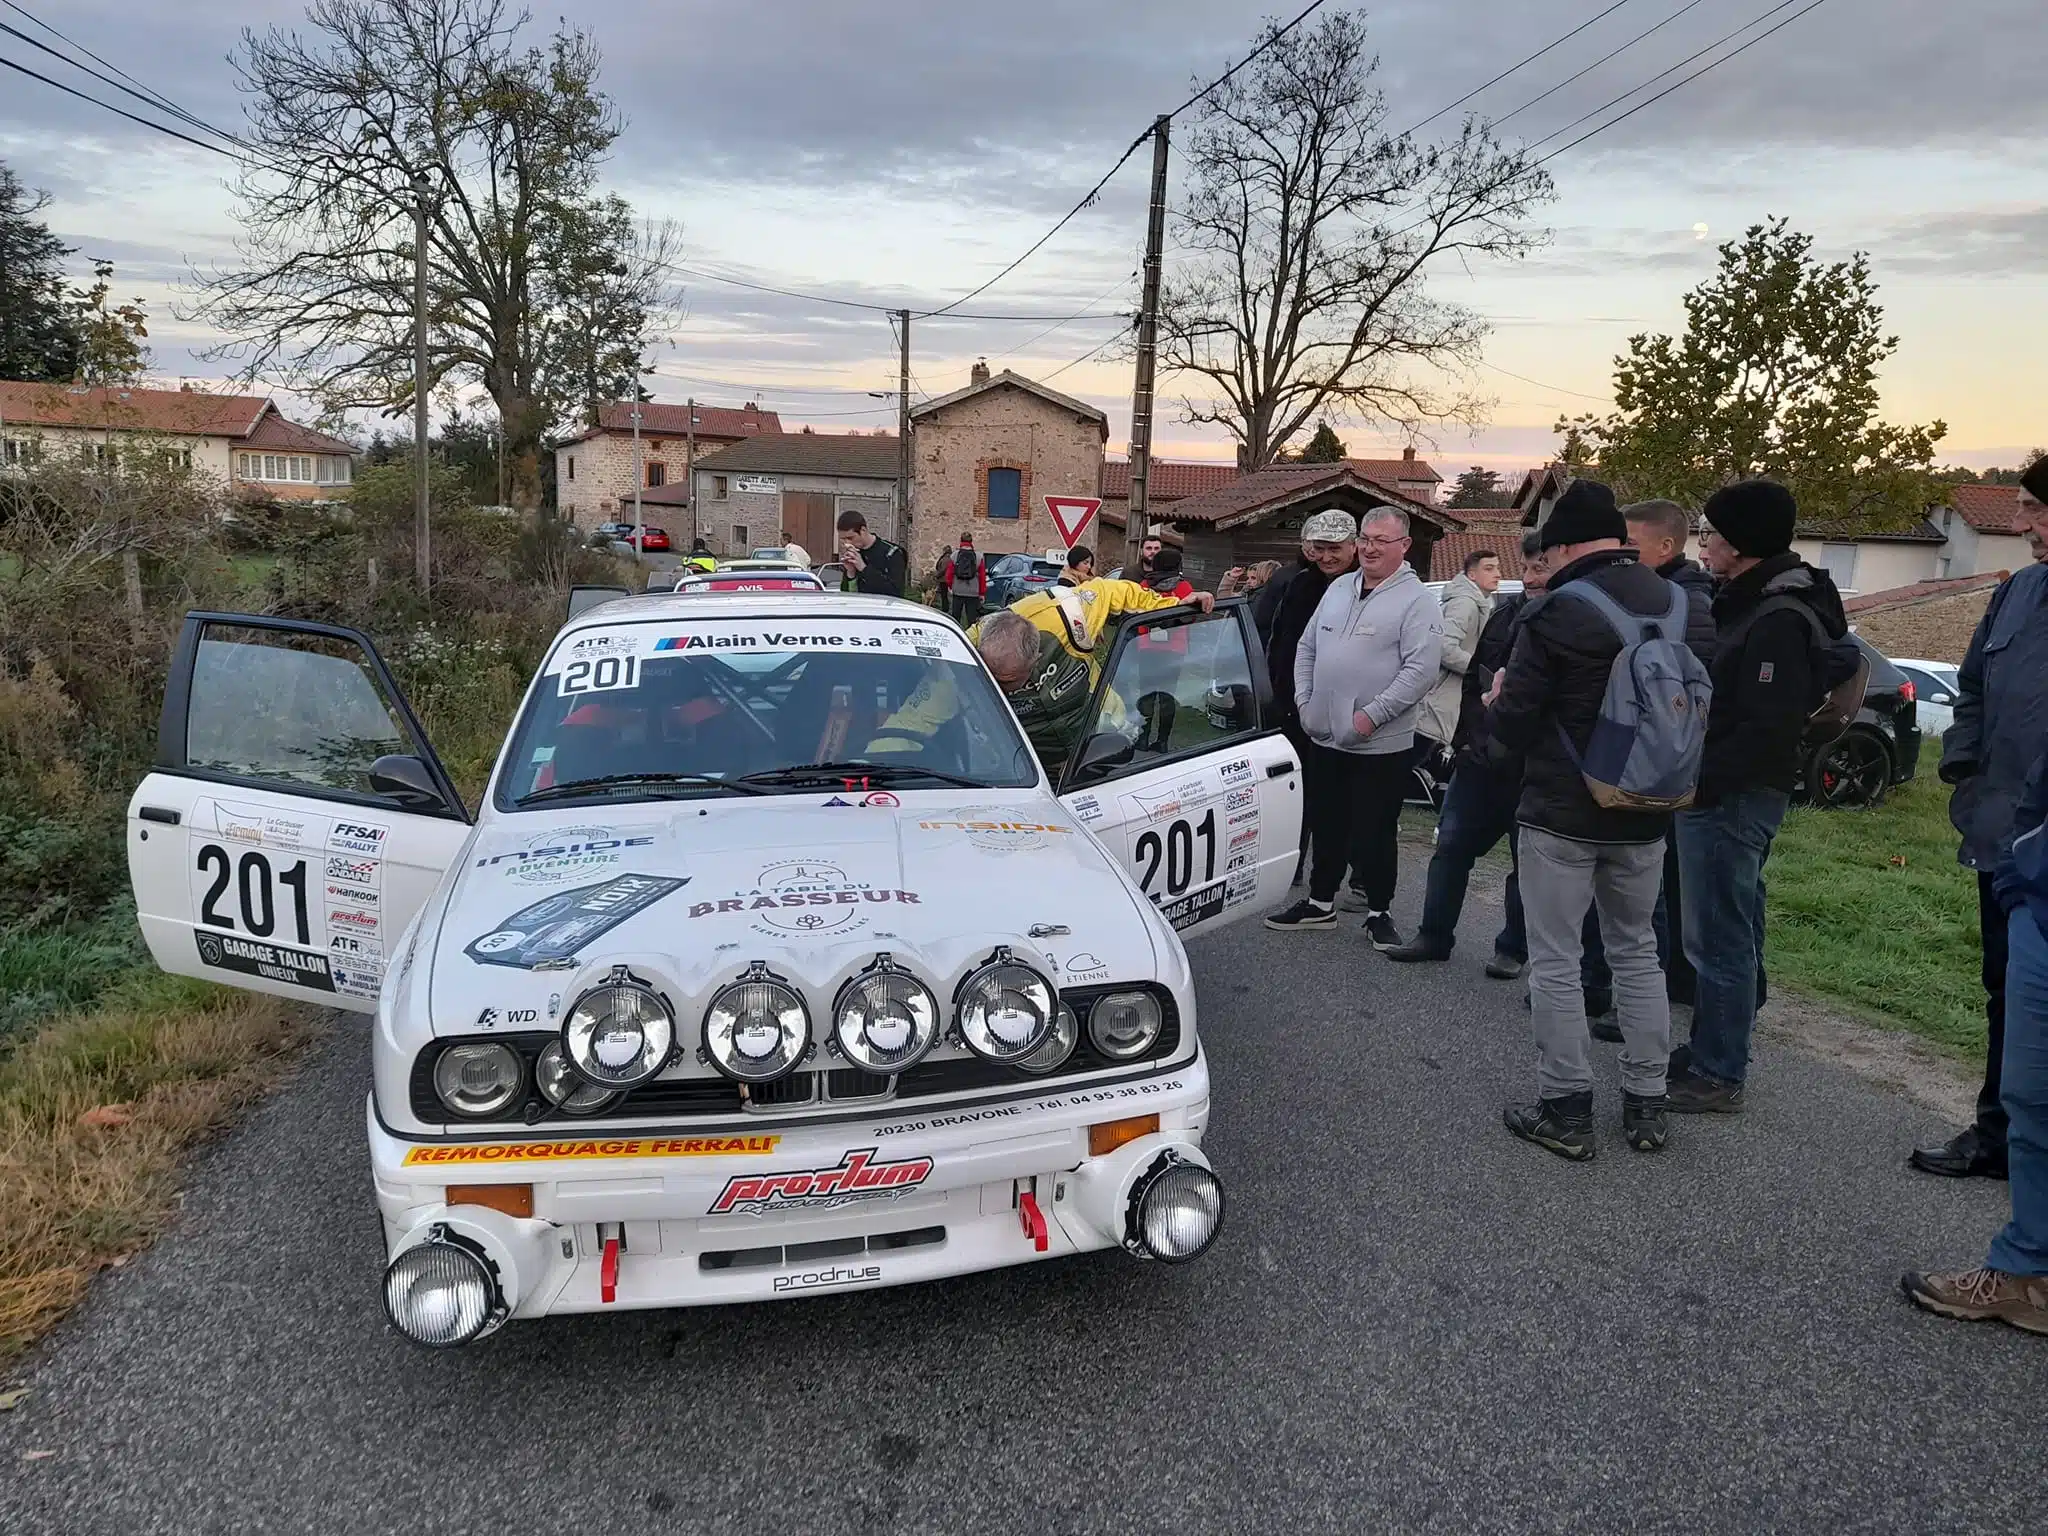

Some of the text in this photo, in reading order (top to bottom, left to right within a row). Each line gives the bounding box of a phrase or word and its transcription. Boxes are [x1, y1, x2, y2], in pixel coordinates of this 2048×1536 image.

[736, 584, 763, 592] AVIS
[686, 634, 756, 648] Alain
[762, 633, 845, 647] Verne
[850, 636, 882, 648] s.a
[891, 627, 923, 636] ATR
[573, 637, 609, 648] ATR
[563, 655, 635, 693] 201
[345, 839, 378, 853] RALLYE
[476, 836, 655, 868] INSIDE
[1135, 808, 1216, 897] 201
[328, 857, 350, 870] ASA
[504, 854, 619, 877] ADVENTURE
[326, 866, 371, 883] ONDAINE
[197, 844, 311, 946] 201
[580, 878, 653, 911] NOIX
[735, 889, 762, 897] LA
[770, 883, 836, 894] TABLE
[1191, 884, 1224, 910] TALLON
[688, 889, 923, 919] BRASSEUR
[331, 936, 359, 952] ATR
[483, 934, 514, 948] 201
[223, 938, 276, 965] GARAGE
[276, 951, 327, 975] TALLON
[258, 963, 300, 983] UNIEUX
[1066, 971, 1110, 983] ETIENNE
[873, 1121, 927, 1138] 20230
[930, 1105, 1022, 1128] BRAVONE
[1070, 1095, 1091, 1106] 04
[1095, 1090, 1115, 1102] 95
[1119, 1086, 1138, 1098] 38
[1141, 1083, 1160, 1095] 83
[1163, 1079, 1184, 1091] 26
[410, 1137, 772, 1162] REMORQUAGE FERRALI
[774, 1266, 881, 1292] prodrive
